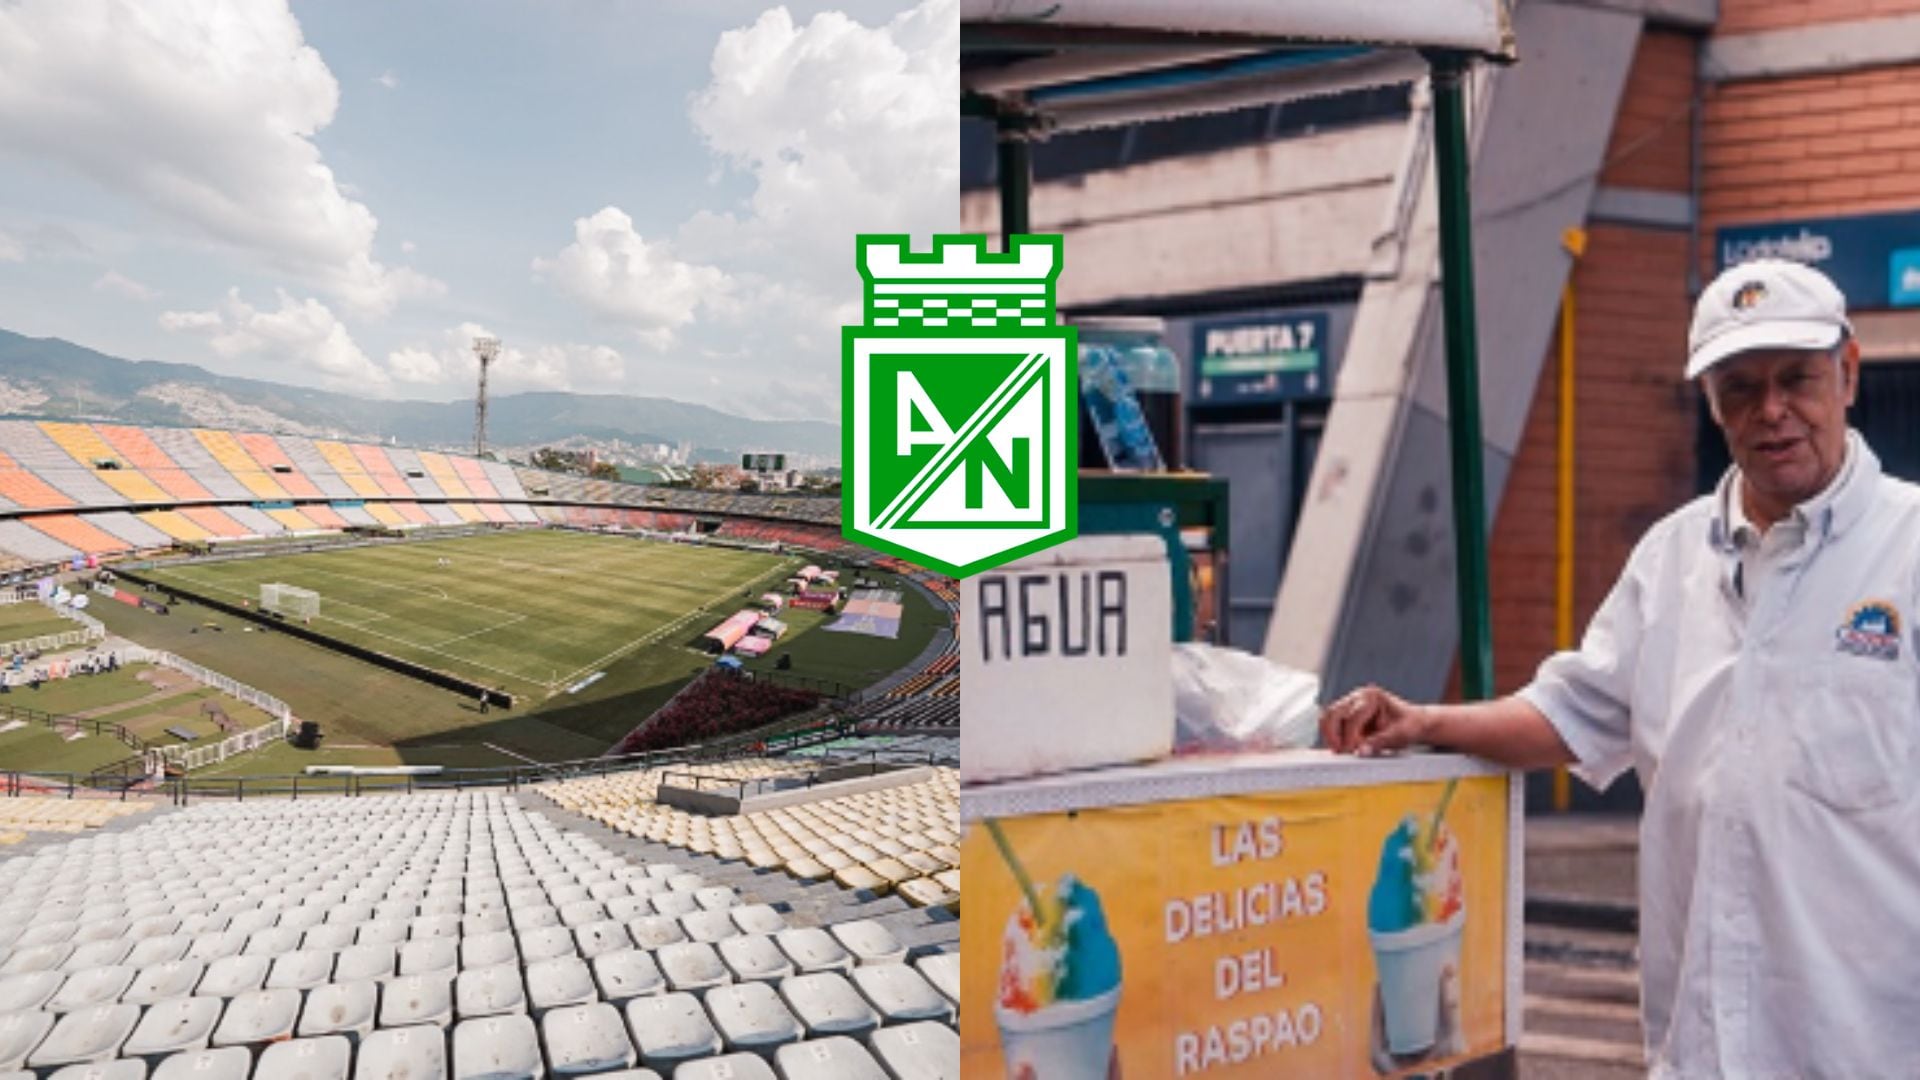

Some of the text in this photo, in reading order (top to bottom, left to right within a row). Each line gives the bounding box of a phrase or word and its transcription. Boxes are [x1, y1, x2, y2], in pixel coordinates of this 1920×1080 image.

[1206, 321, 1316, 357] PUERTA 7
[979, 571, 1127, 662] AGUA
[1211, 816, 1283, 868] LAS
[1164, 872, 1328, 943] DELICIAS
[1214, 948, 1286, 998] DEL
[1175, 1002, 1322, 1077] RASPAO
